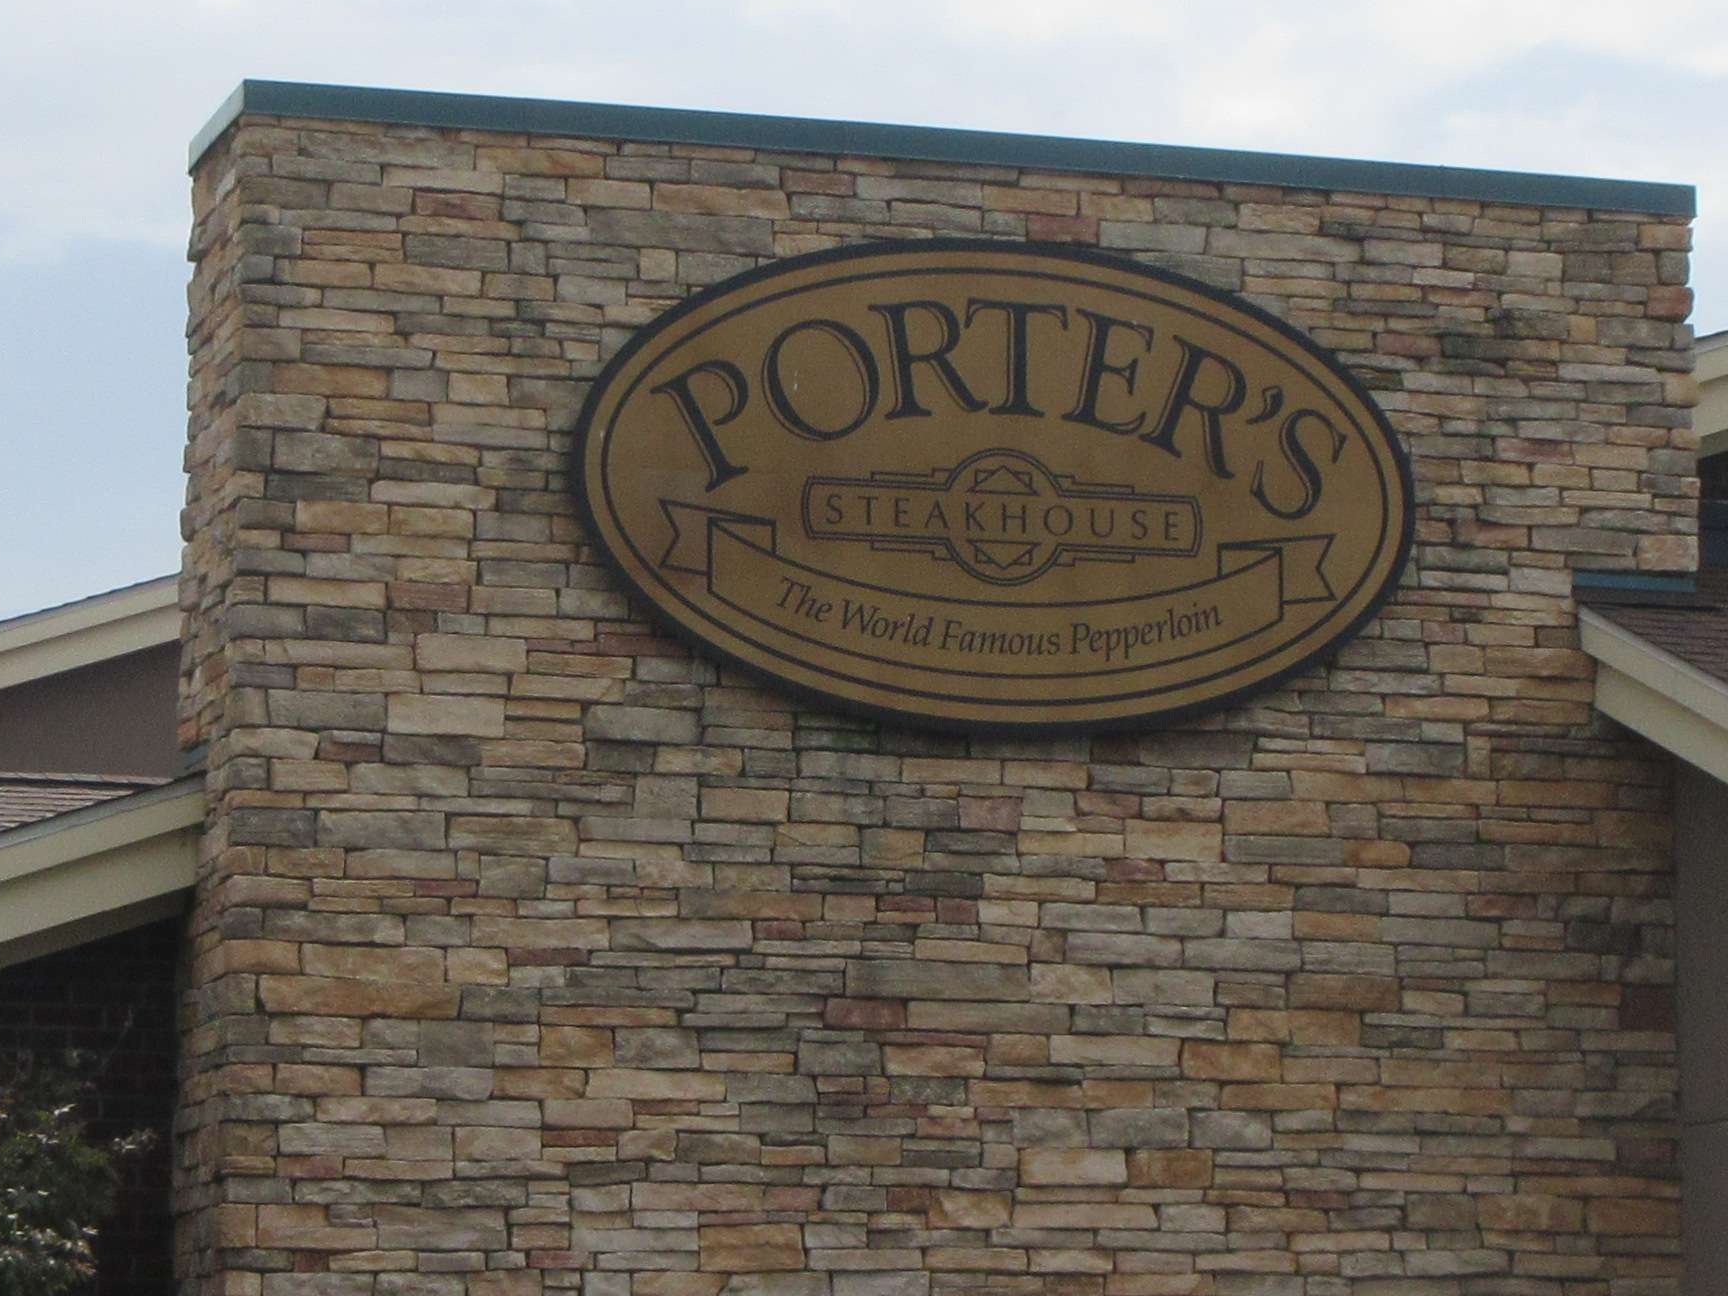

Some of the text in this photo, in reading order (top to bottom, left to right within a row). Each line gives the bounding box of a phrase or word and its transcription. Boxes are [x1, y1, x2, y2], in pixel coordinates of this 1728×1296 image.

[650, 298, 1347, 521] PORTER'S
[825, 493, 1182, 542] STEAKHOUSE
[775, 575, 1224, 661] The World Famous Pepperloin
